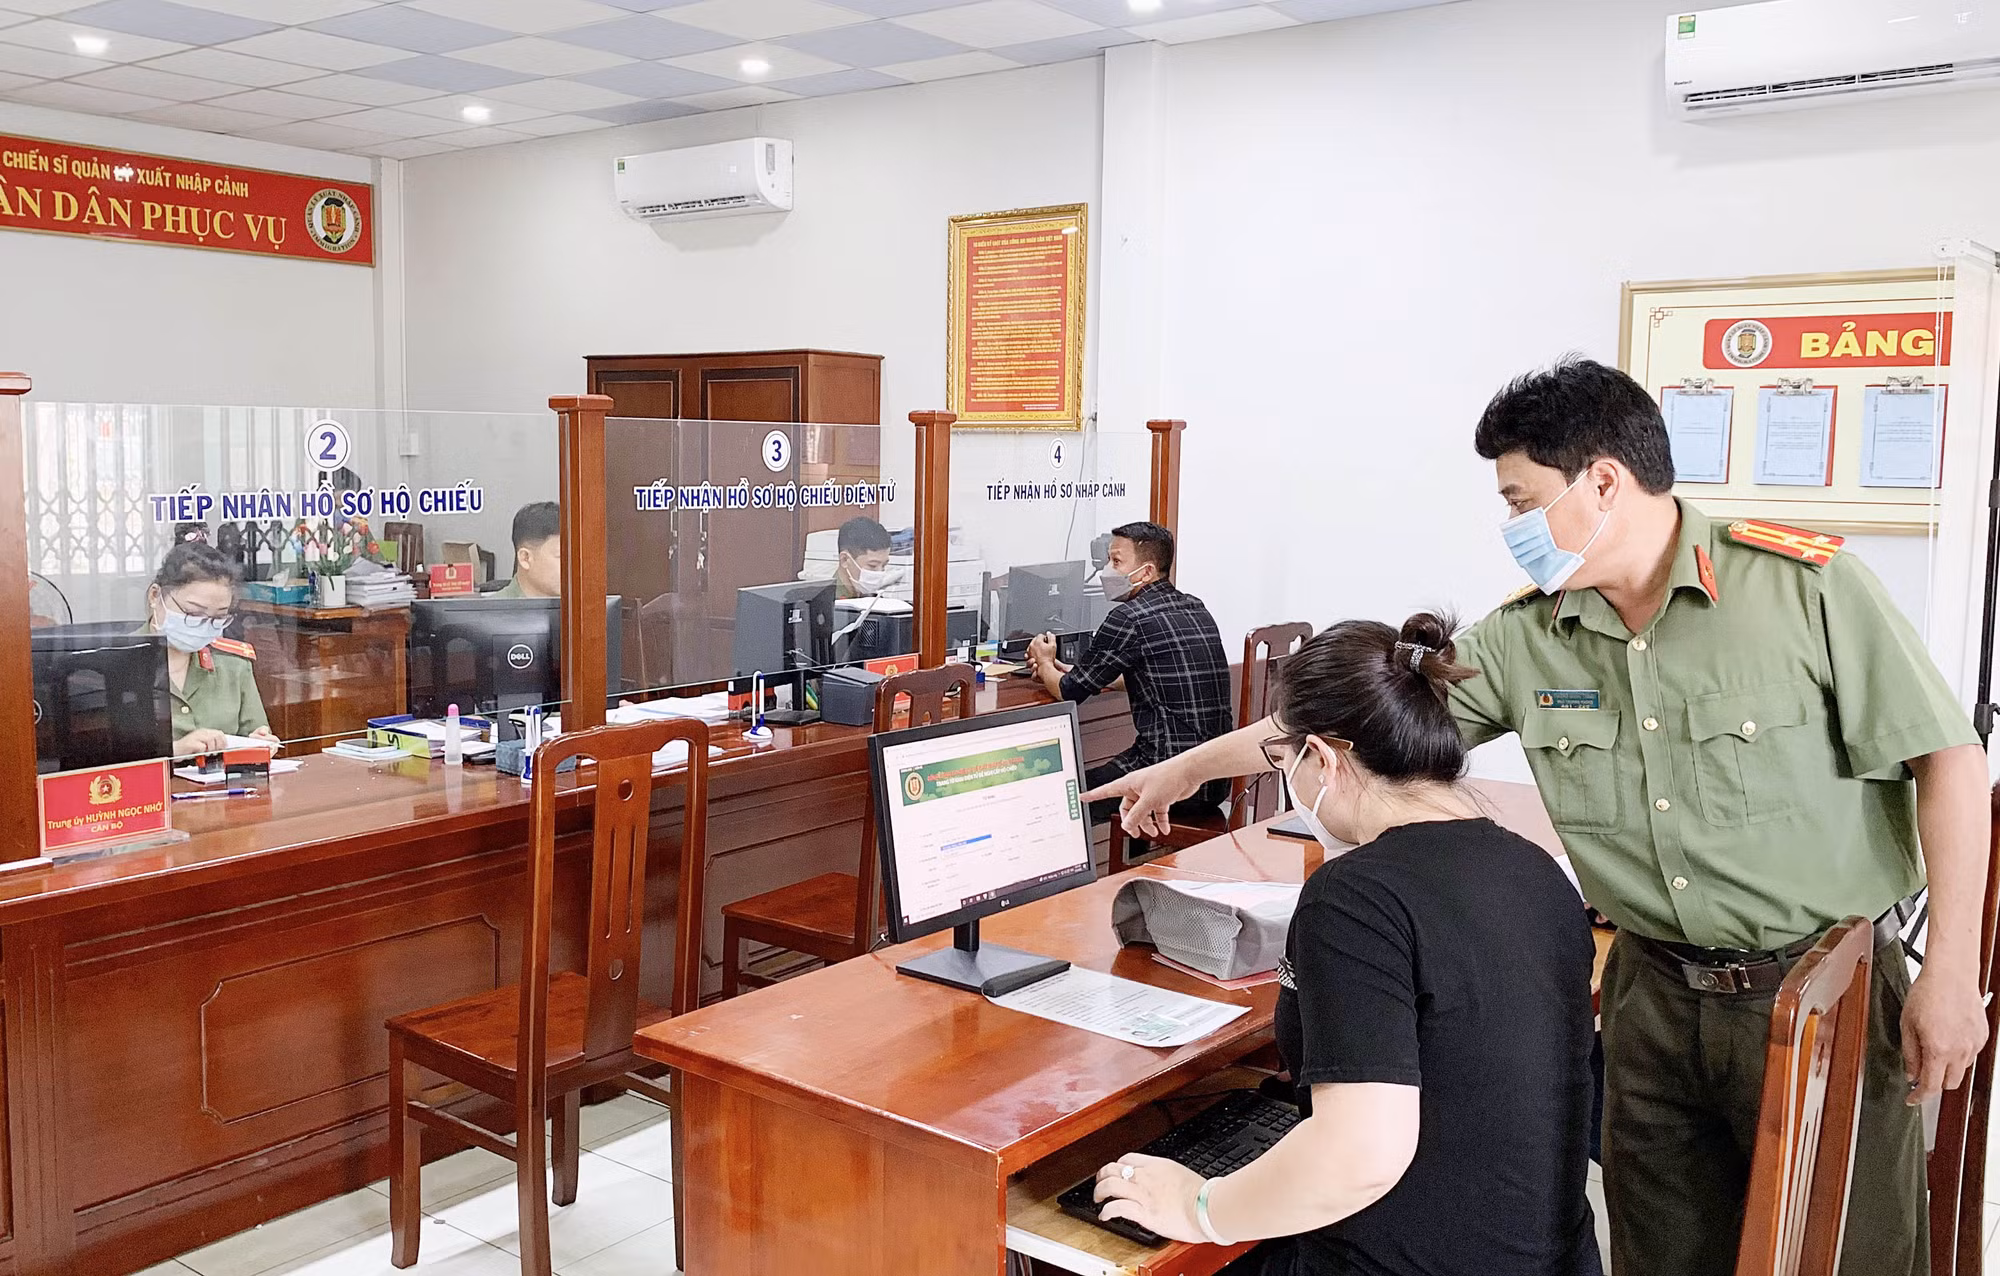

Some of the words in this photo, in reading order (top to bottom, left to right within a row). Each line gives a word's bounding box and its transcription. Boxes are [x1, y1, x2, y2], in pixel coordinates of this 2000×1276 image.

[2, 148, 49, 172] CHIẾN
[53, 154, 68, 175] SĨ
[72, 157, 111, 180] QUẢN
[136, 165, 172, 188] XUẤT
[176, 172, 211, 195] NHẬP
[214, 174, 249, 198] CẢNH
[52, 185, 133, 229] DÂN
[142, 201, 235, 243] PHỤC
[243, 213, 287, 250] VỤ
[1799, 321, 1935, 358] BẢNG
[319, 431, 337, 461] 2
[770, 440, 783, 461] 3
[1054, 445, 1062, 464] 4
[150, 484, 213, 521] TIẾP
[222, 488, 291, 524] NHẬN
[301, 481, 334, 517] HỒ
[343, 488, 373, 516] SƠ
[381, 485, 411, 519] HỘ
[419, 480, 482, 513] CHIẾU
[636, 478, 675, 508] TIẾP
[679, 482, 722, 512] NHẬN
[728, 478, 748, 507] HỒ
[753, 484, 773, 507] SƠ
[777, 483, 796, 510] HỘ
[801, 479, 841, 505] CHIẾU
[845, 481, 875, 507] ĐIỆN
[879, 478, 897, 502] TỬ
[986, 477, 1011, 500] TIẾP
[1013, 480, 1041, 503] NHẬN
[1043, 477, 1057, 499] HỒ
[1060, 481, 1074, 498] SƠ
[1075, 479, 1100, 501] NHẬP
[1102, 476, 1126, 498] CẢNH
[47, 819, 73, 830] Trung
[86, 810, 117, 823] HUỲNH
[118, 805, 142, 817] NGỌC
